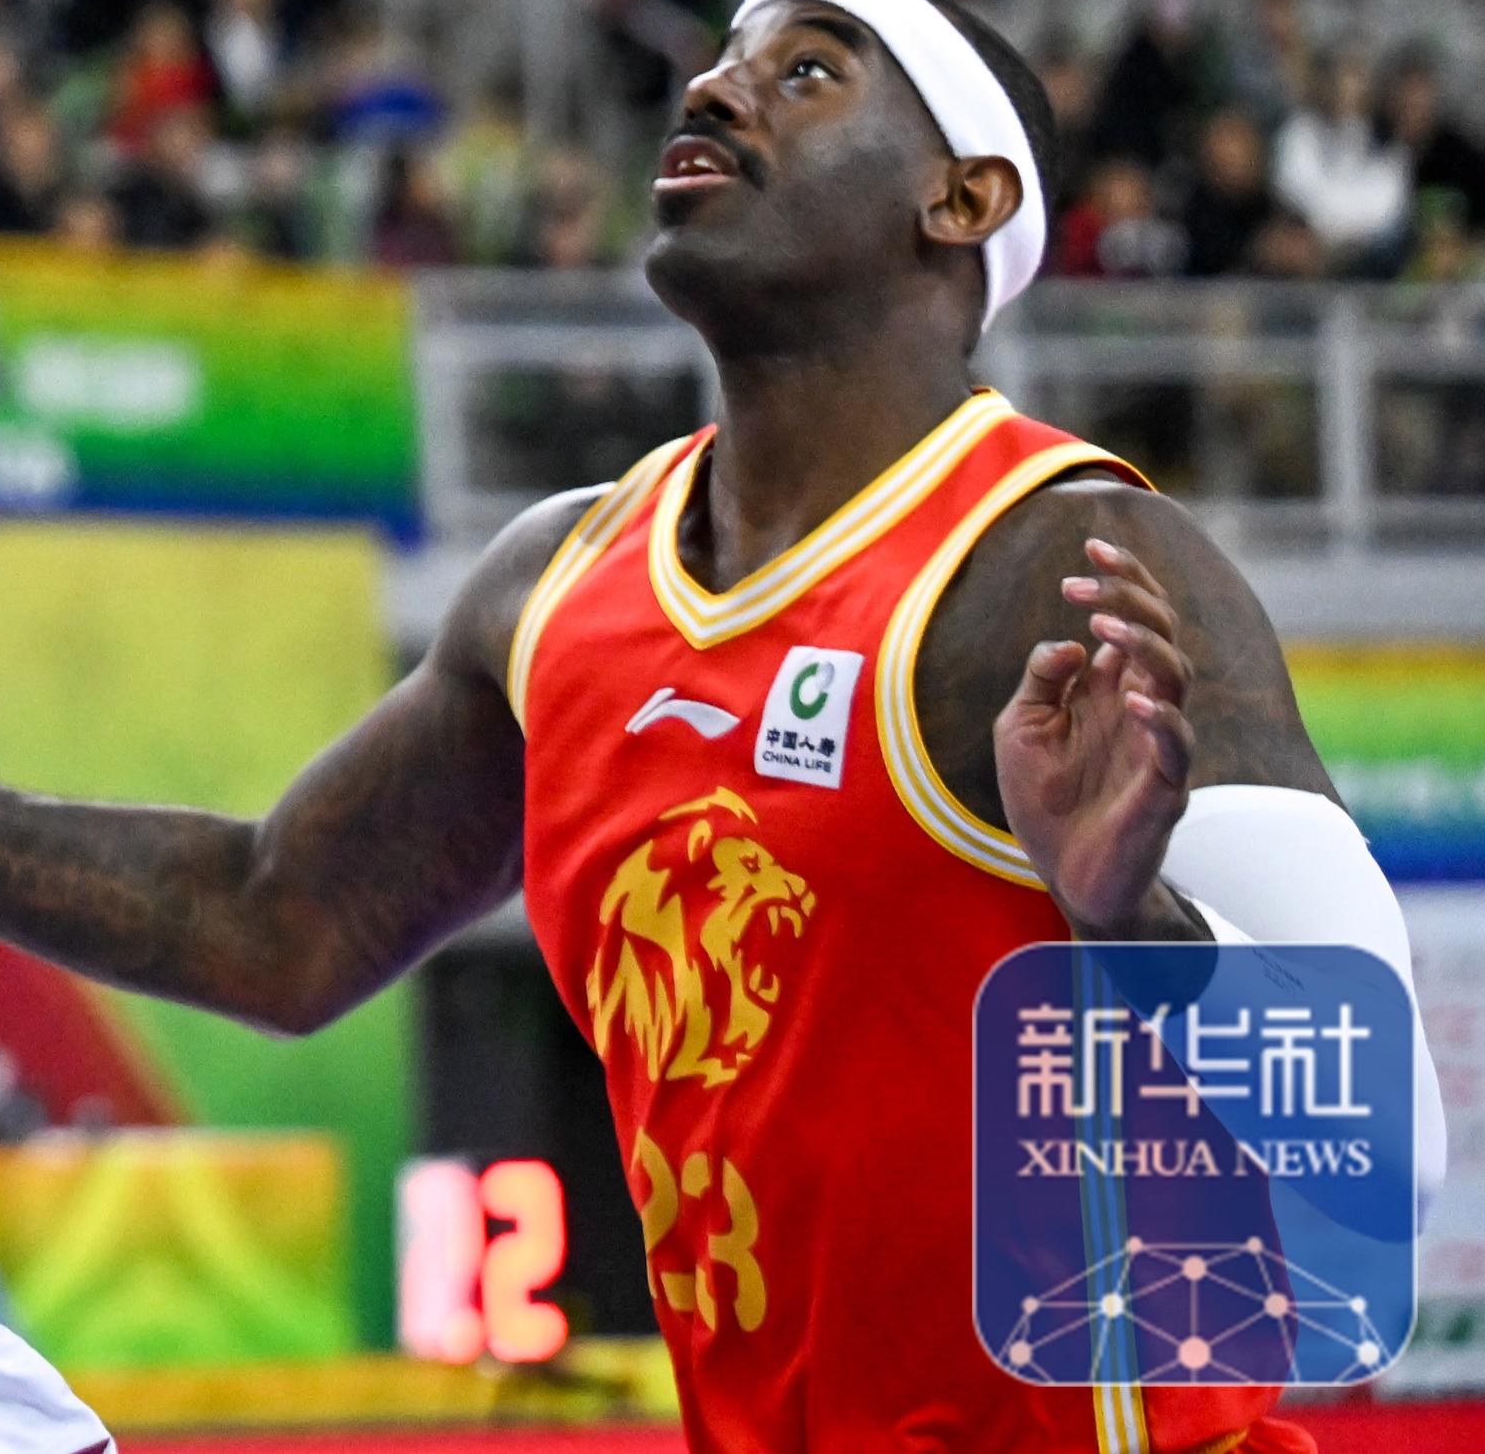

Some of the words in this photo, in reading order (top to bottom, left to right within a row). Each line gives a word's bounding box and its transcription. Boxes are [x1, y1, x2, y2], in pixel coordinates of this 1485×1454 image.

[766, 727, 835, 758] 中国人寿
[762, 750, 800, 767] CHINA
[804, 758, 832, 773] LIFE
[631, 1125, 767, 1333] 23
